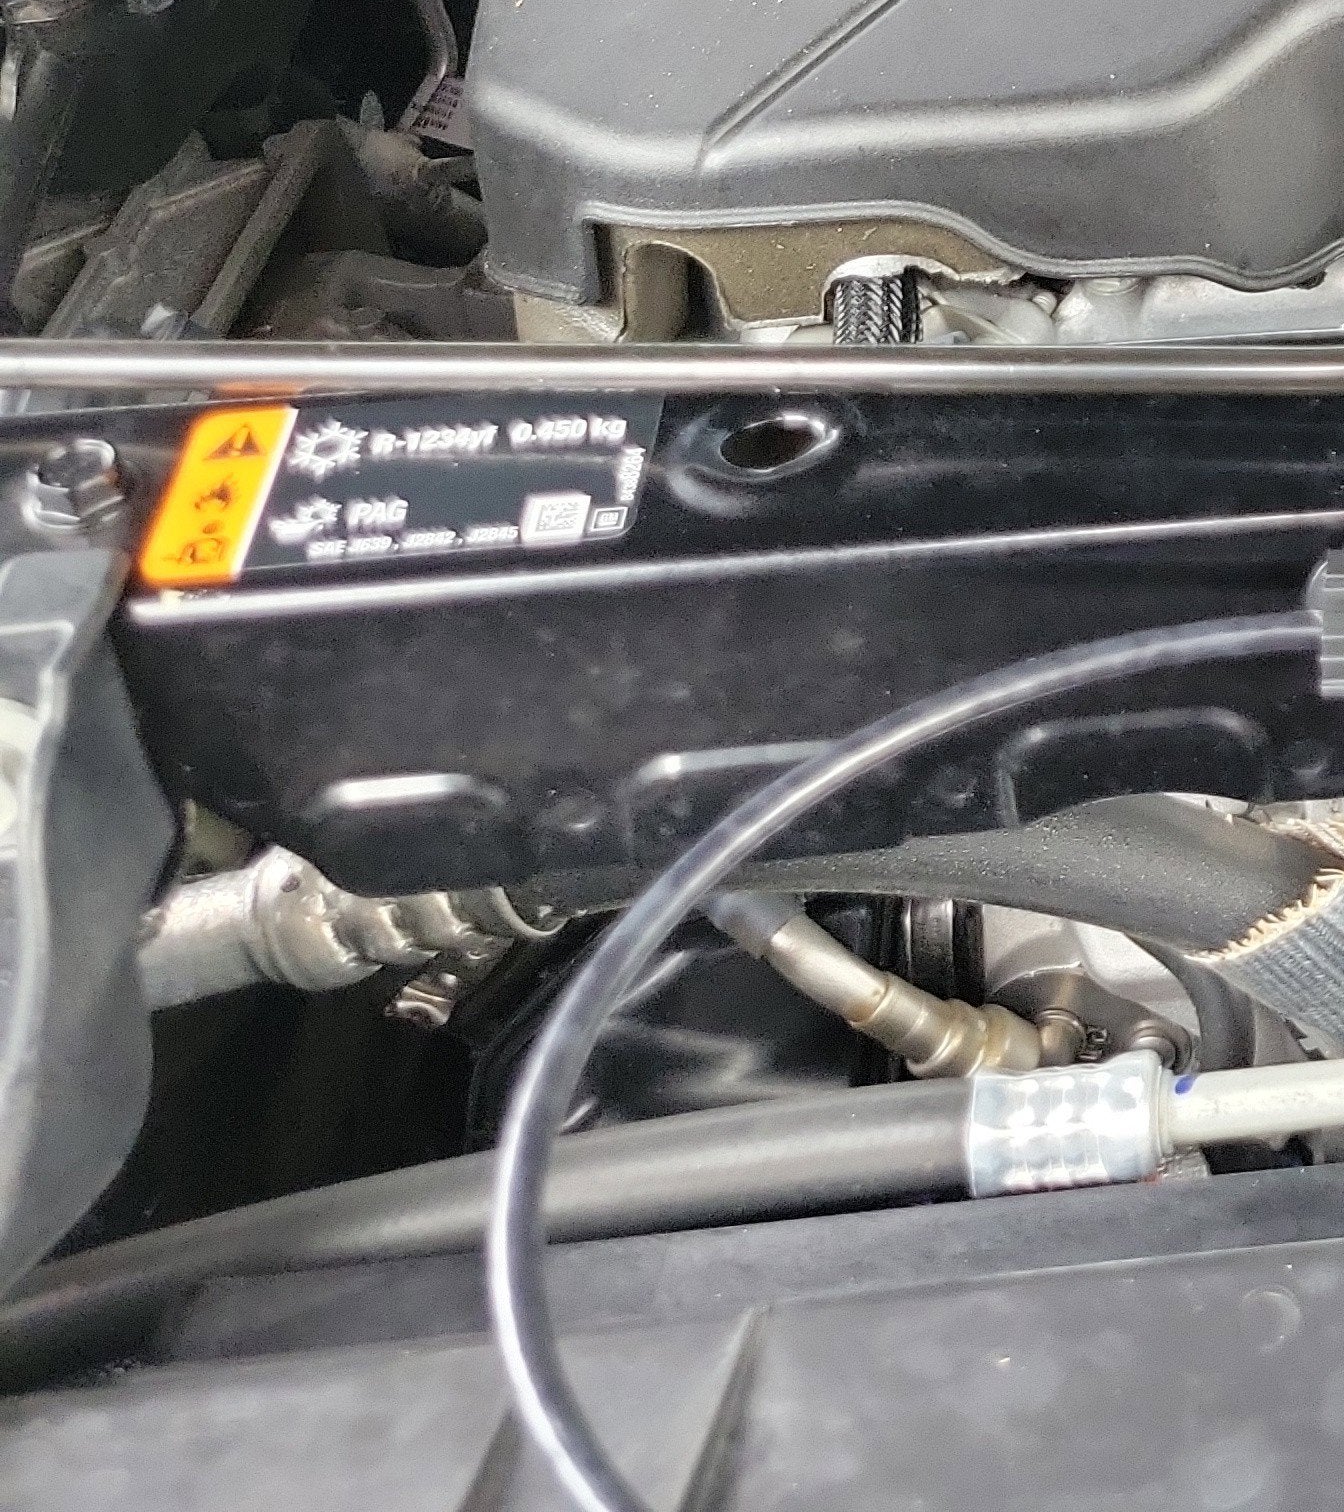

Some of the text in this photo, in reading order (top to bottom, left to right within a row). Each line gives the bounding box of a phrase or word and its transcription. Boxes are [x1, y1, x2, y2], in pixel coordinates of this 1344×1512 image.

[371, 416, 627, 456] R-1234yf 0.450 kg
[348, 497, 409, 524] PAG
[308, 540, 348, 559] SAE
